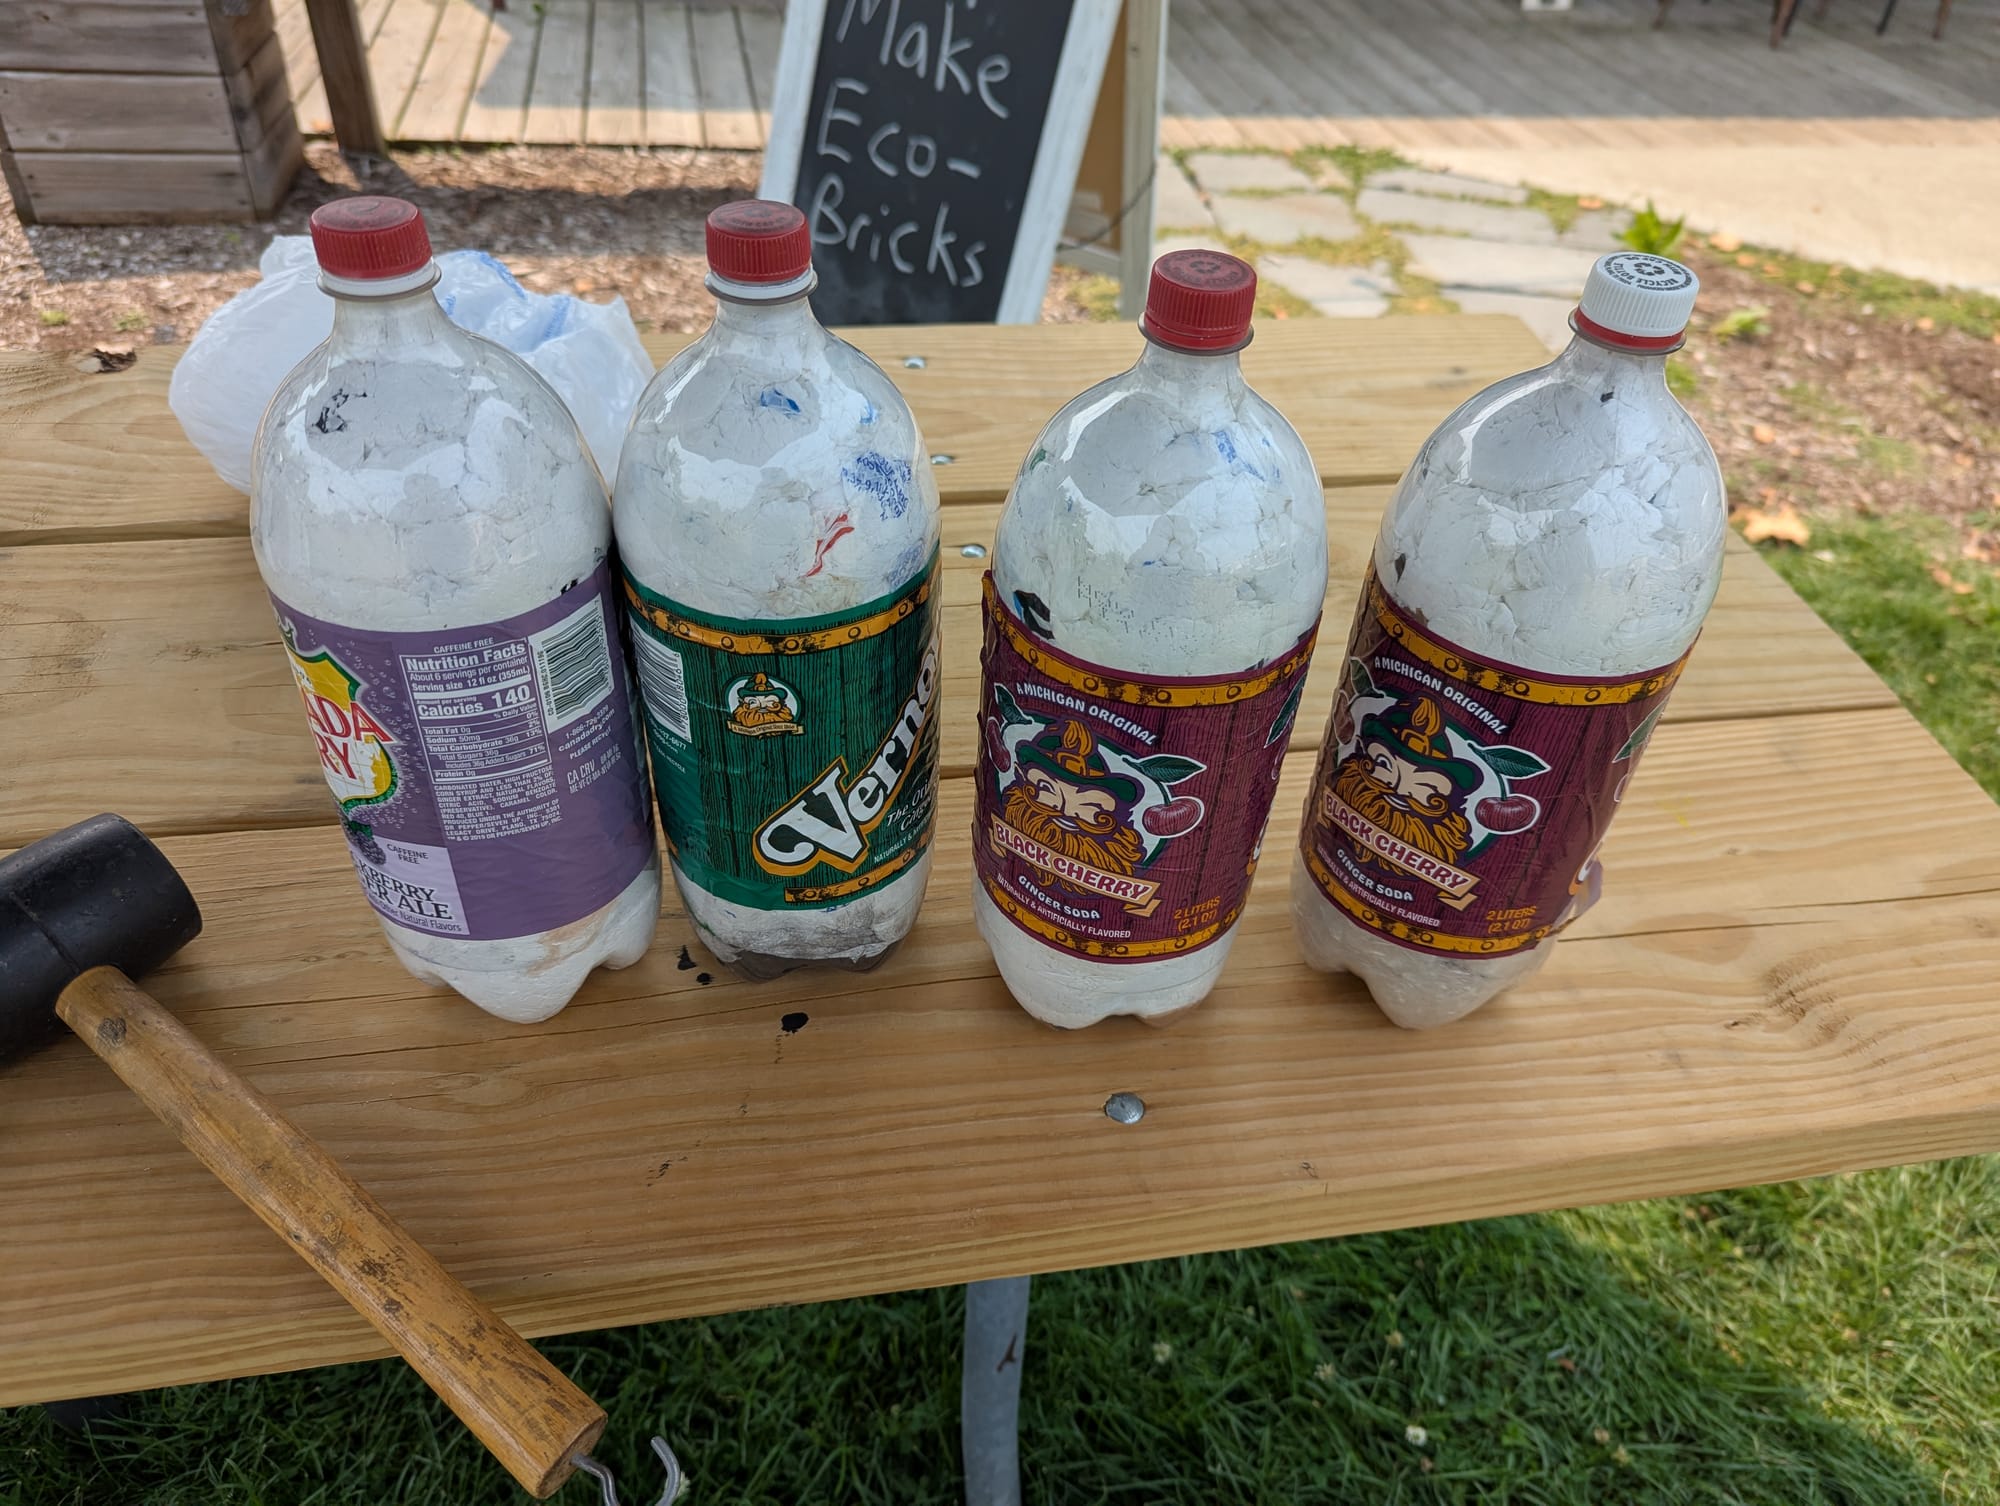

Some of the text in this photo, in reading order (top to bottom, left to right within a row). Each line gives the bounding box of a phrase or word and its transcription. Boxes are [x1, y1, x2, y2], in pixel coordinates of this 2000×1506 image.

[837, 0, 1010, 118] Make
[817, 78, 981, 179] Eco-
[812, 172, 986, 288] Bricks
[434, 637, 494, 653] CAFFEINE FREE
[405, 643, 526, 671] Nutrition Facts
[410, 656, 528, 681] About 6 servings per container
[412, 683, 444, 692] Serving
[445, 681, 463, 689] size
[467, 679, 478, 687] 12
[478, 678, 487, 686] fl
[498, 666, 530, 682] (355mL)
[418, 684, 531, 716] Calories 140
[1375, 656, 1508, 734] A MICHIGAN ORIGINAL
[502, 708, 519, 717] Daily
[526, 710, 538, 719] 0%
[1016, 682, 1157, 745] A MICHIGAN ORIGINAL
[424, 727, 444, 735] Total
[426, 736, 457, 744] Sodium
[558, 708, 615, 752] canadadry.com
[428, 744, 448, 752] Total
[450, 738, 504, 751] Carbohydrate
[457, 750, 484, 760] Sugars
[570, 742, 592, 760] PLEASE
[486, 754, 504, 765] Added
[435, 770, 464, 778] Protein
[522, 764, 553, 779] FRUCTOSE
[567, 769, 579, 785] CA
[580, 759, 595, 777] CRV
[493, 794, 519, 803] SODIUM
[526, 783, 556, 796] BENZOATE
[496, 787, 525, 797] NATURAL
[514, 779, 531, 787] THAN
[478, 814, 501, 822] UNDER
[517, 802, 550, 816] AUTHORITY
[500, 797, 530, 808] CARAMEL
[888, 804, 908, 826] The
[386, 843, 429, 860] CAFFEINE
[874, 838, 906, 863] NATURALLY
[1326, 793, 1469, 890] BLACK CHERRY
[398, 854, 420, 865] FREE
[995, 822, 1151, 900] BLACK CHERRY
[1337, 849, 1413, 901] GINGER SODA
[398, 895, 453, 920] ALE
[998, 873, 1029, 905] NATURALLY
[1037, 905, 1087, 932] ARTIFICIALLY
[1088, 927, 1131, 938] FLAVORED
[1018, 875, 1100, 919] GINGER SODA
[1174, 896, 1220, 919] 2 LITERS
[1349, 881, 1396, 913] ARTIFICIALLY
[1398, 908, 1440, 927] FLAVORED
[400, 911, 462, 932] Natural Flavors
[1178, 909, 1217, 932] (2.1 QT)
[1486, 906, 1537, 920] 2 LITERS
